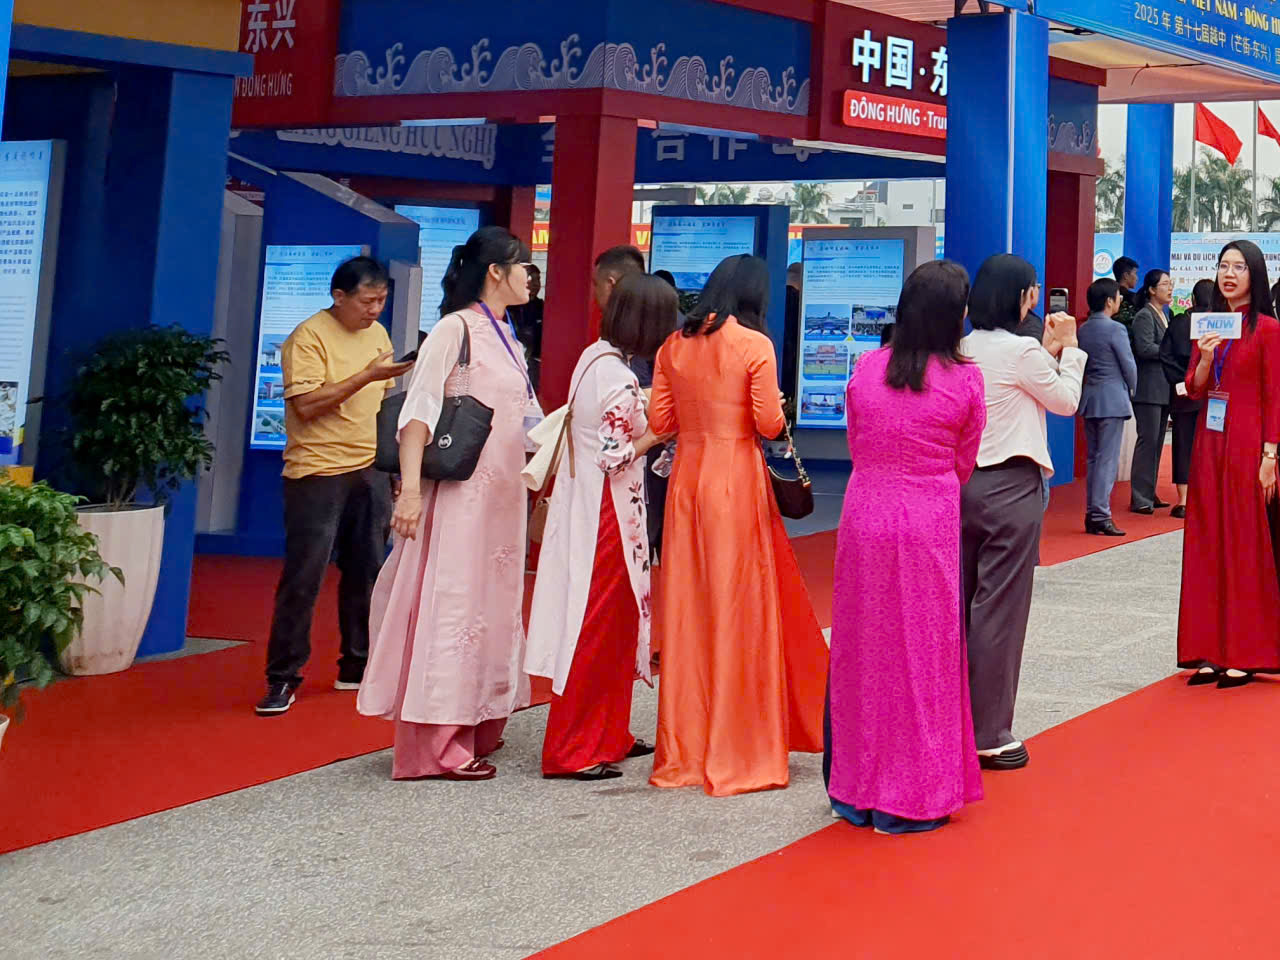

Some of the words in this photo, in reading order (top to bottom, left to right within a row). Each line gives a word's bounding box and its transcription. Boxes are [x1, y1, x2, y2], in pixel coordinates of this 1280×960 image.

[1134, 2, 1159, 26] 2025
[850, 96, 885, 122] ĐÔNG
[886, 103, 921, 127] HƯNG
[1193, 253, 1201, 261] DU
